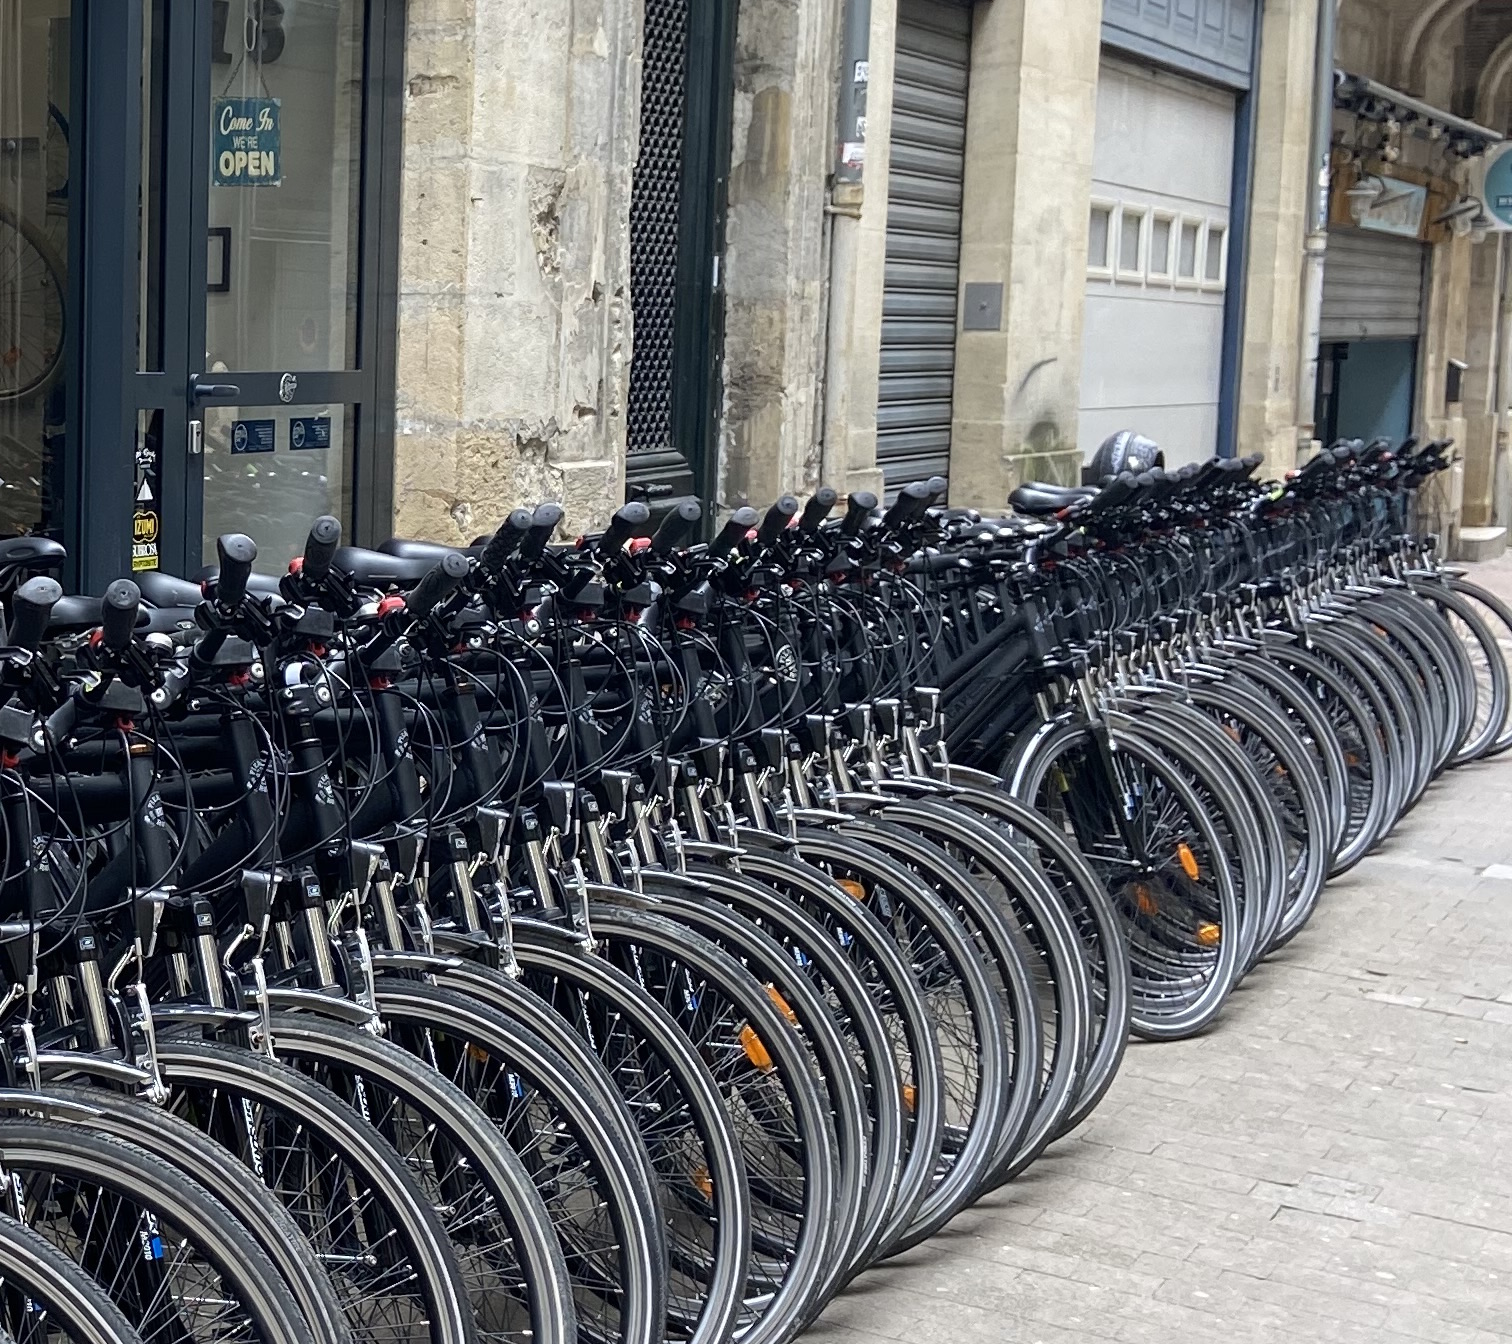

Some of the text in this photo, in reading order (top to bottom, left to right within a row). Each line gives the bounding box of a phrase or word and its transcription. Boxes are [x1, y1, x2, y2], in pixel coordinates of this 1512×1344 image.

[220, 106, 275, 136] Come In
[219, 150, 276, 177] OPEN
